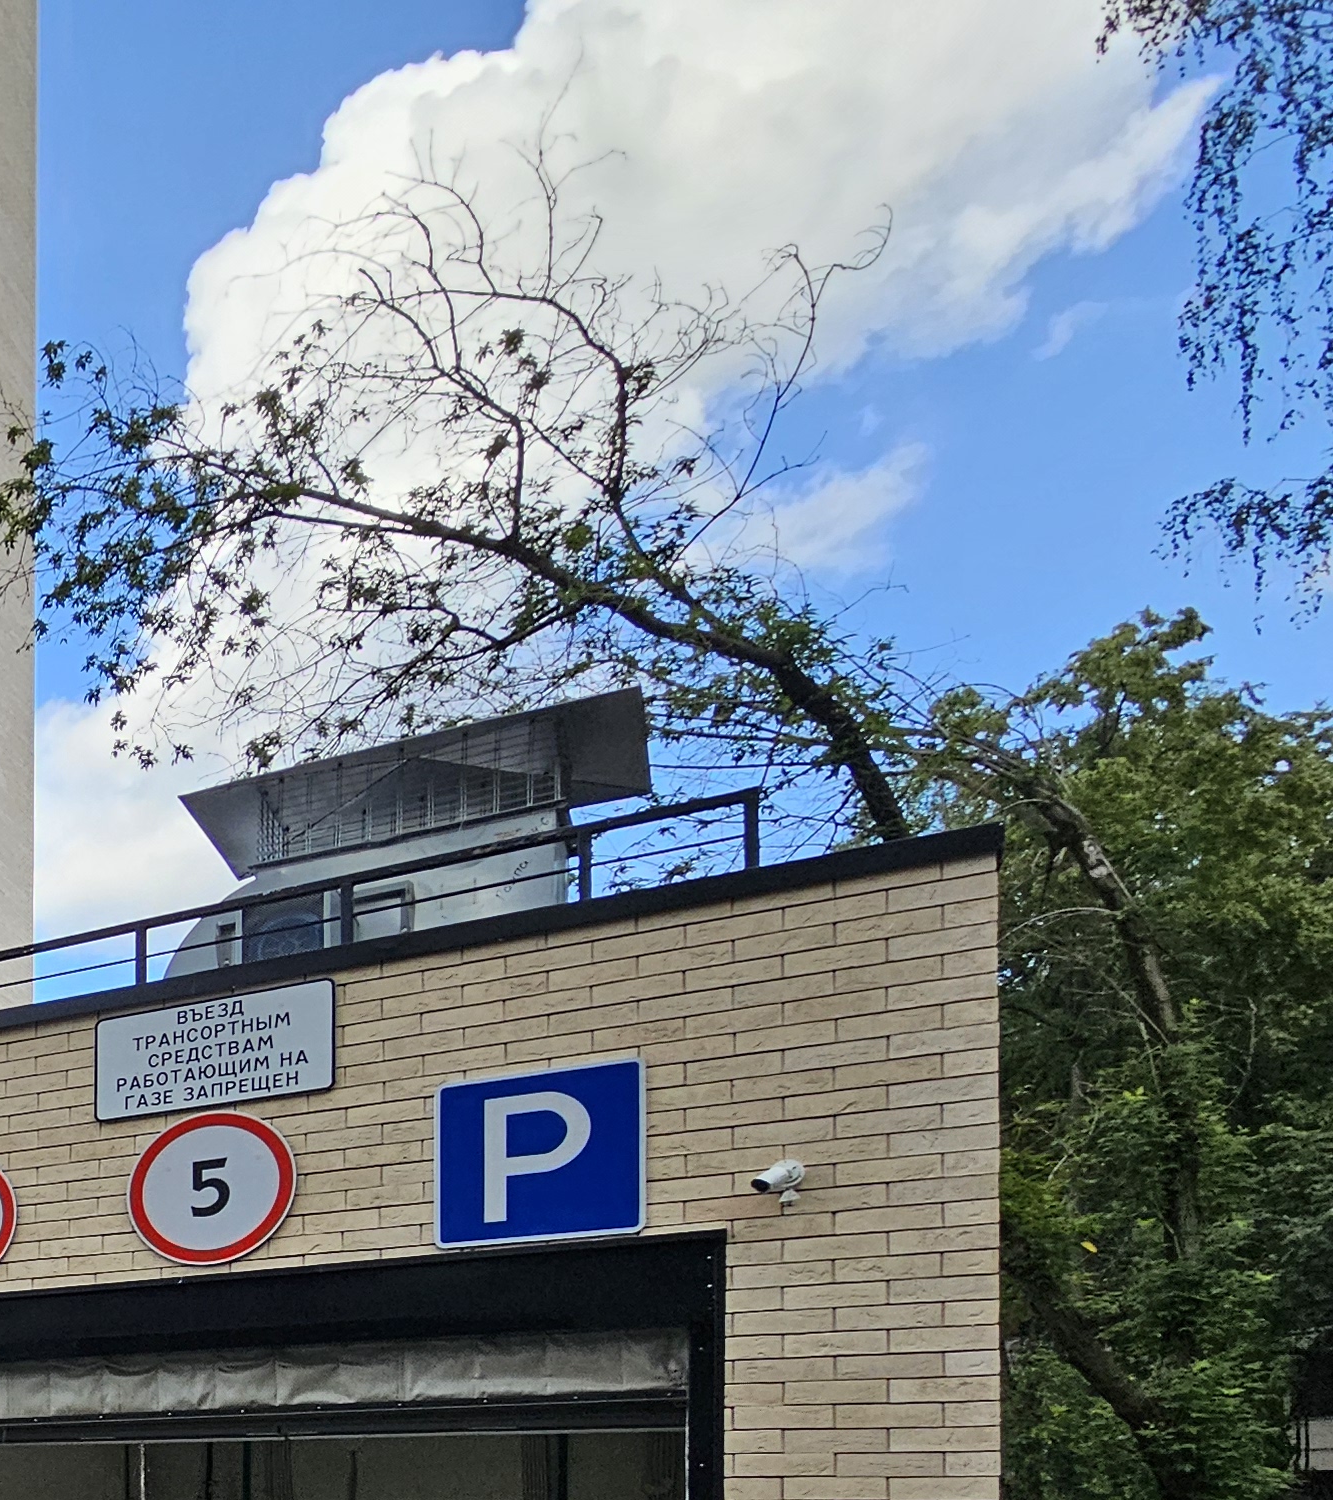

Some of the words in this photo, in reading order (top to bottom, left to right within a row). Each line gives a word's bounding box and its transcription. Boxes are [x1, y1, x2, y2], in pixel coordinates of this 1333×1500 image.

[133, 1012, 291, 1051] ТРАНСОРТНЫМ
[177, 1000, 244, 1025] ВЪЕЗД
[116, 1055, 270, 1093] РАБОТАЮЩИМ
[280, 1049, 309, 1068] НА
[148, 1035, 274, 1068] СРЕДСТВАМ
[124, 1089, 174, 1110] ГАЗЕ
[183, 1070, 300, 1102] ЗАПРЕЩЕН
[483, 1091, 592, 1224] P
[190, 1156, 231, 1218] 5
